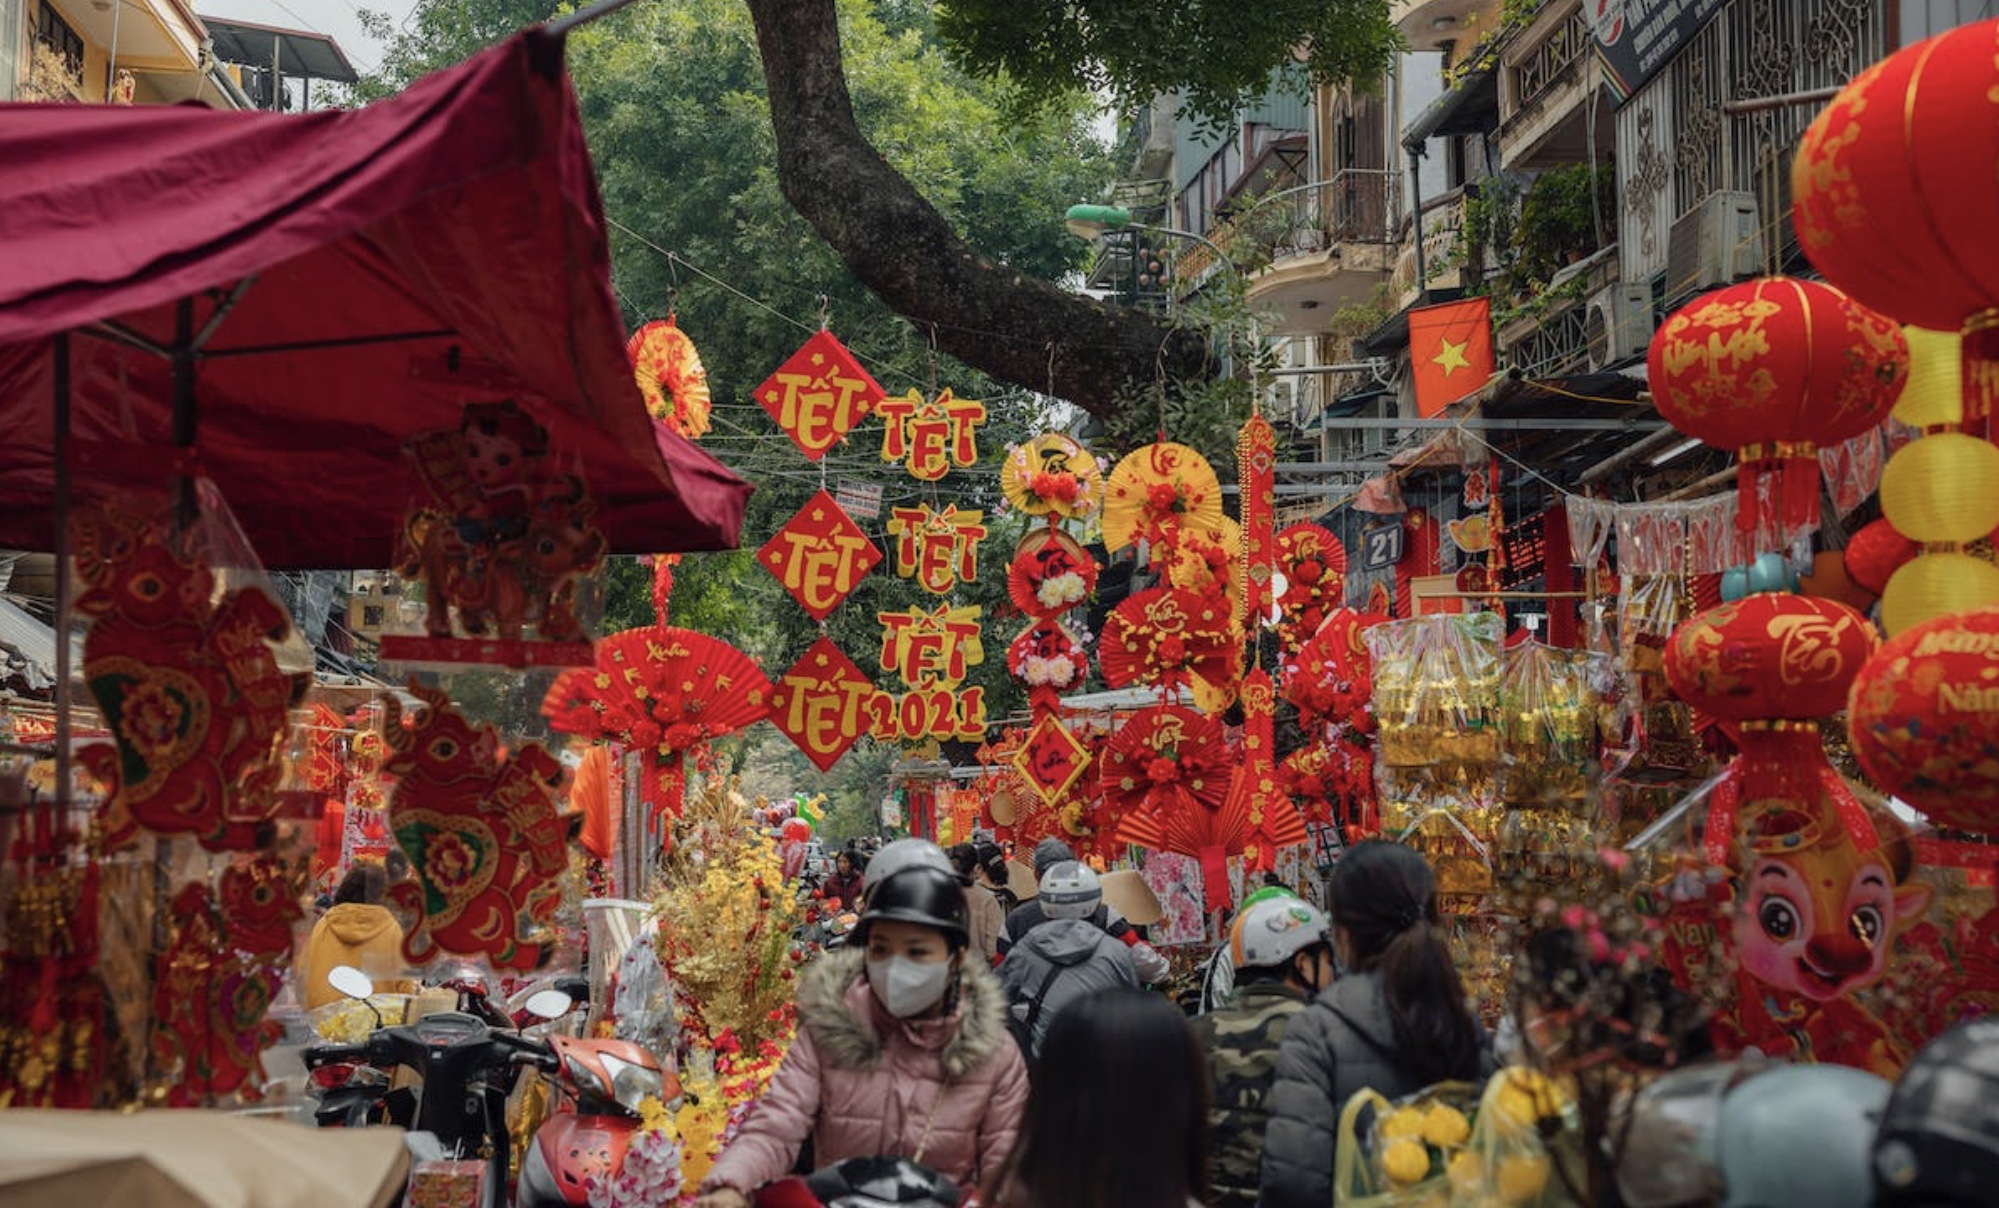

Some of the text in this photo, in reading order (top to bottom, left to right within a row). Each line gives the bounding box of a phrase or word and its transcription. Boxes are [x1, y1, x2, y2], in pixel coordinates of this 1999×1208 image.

[776, 364, 867, 450] TẾT
[877, 389, 986, 480] TẾT
[784, 522, 867, 610] TẾT
[893, 504, 987, 593] TẾT
[1370, 529, 1399, 566] 21
[878, 604, 982, 691] TẾT
[784, 667, 874, 753] TẾT
[870, 687, 986, 741] 2021
